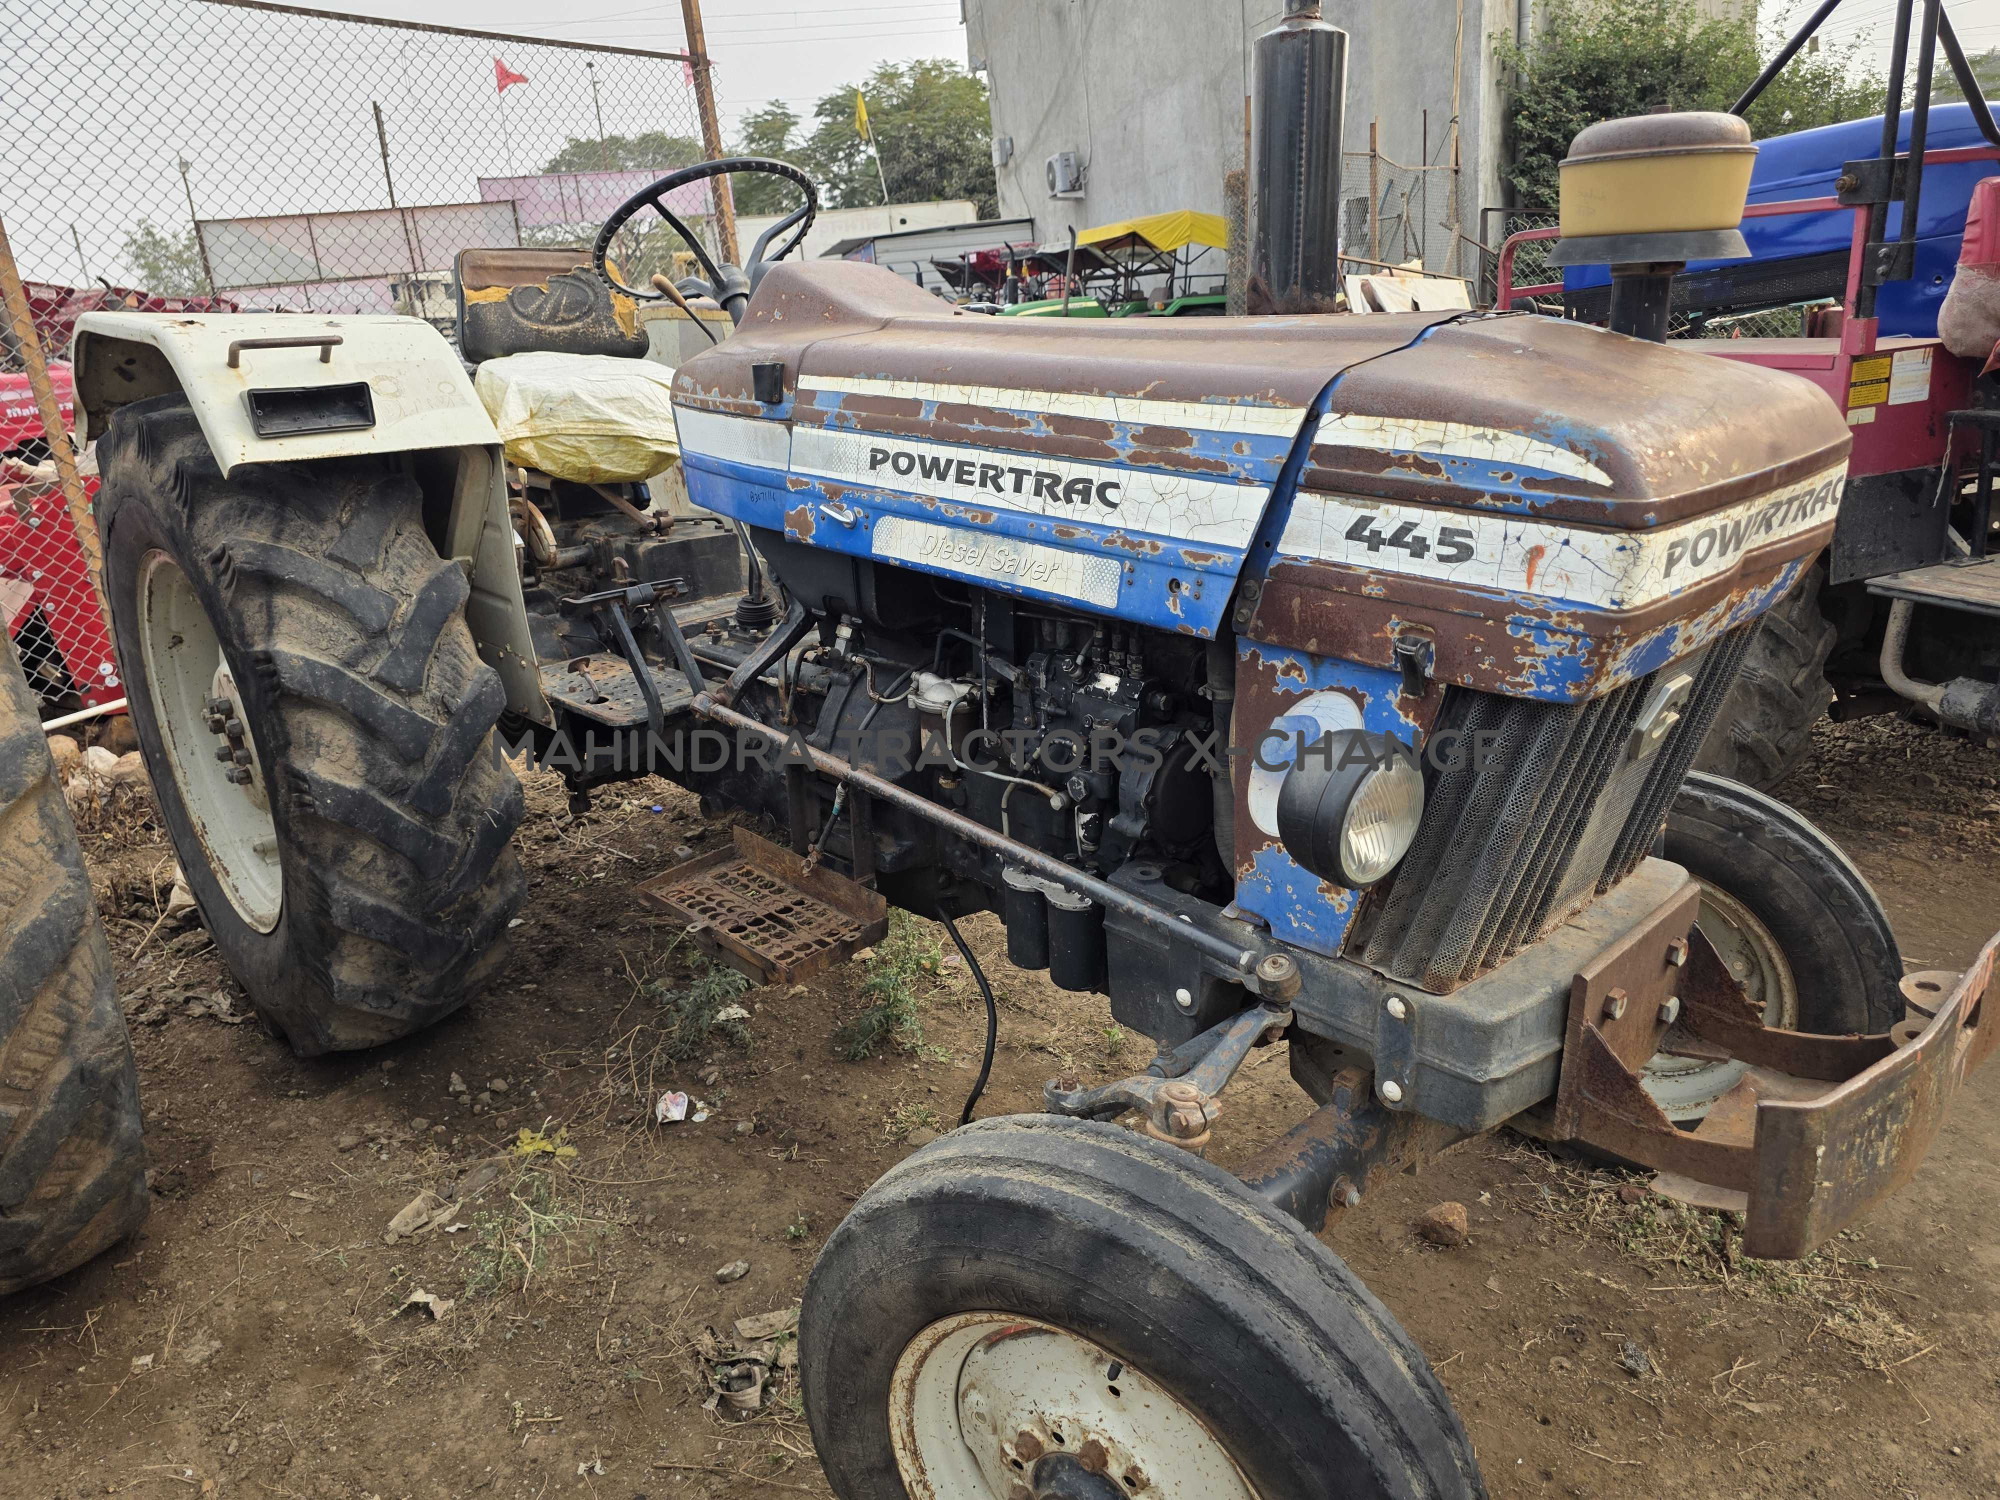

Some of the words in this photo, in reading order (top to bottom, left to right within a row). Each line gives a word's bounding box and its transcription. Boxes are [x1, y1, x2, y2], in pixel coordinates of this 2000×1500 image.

[6, 403, 73, 418] Mahra
[869, 447, 1121, 509] POWERTRAC
[919, 534, 990, 567] Diesel
[991, 547, 1060, 583] Saver
[1345, 514, 1475, 564] 445
